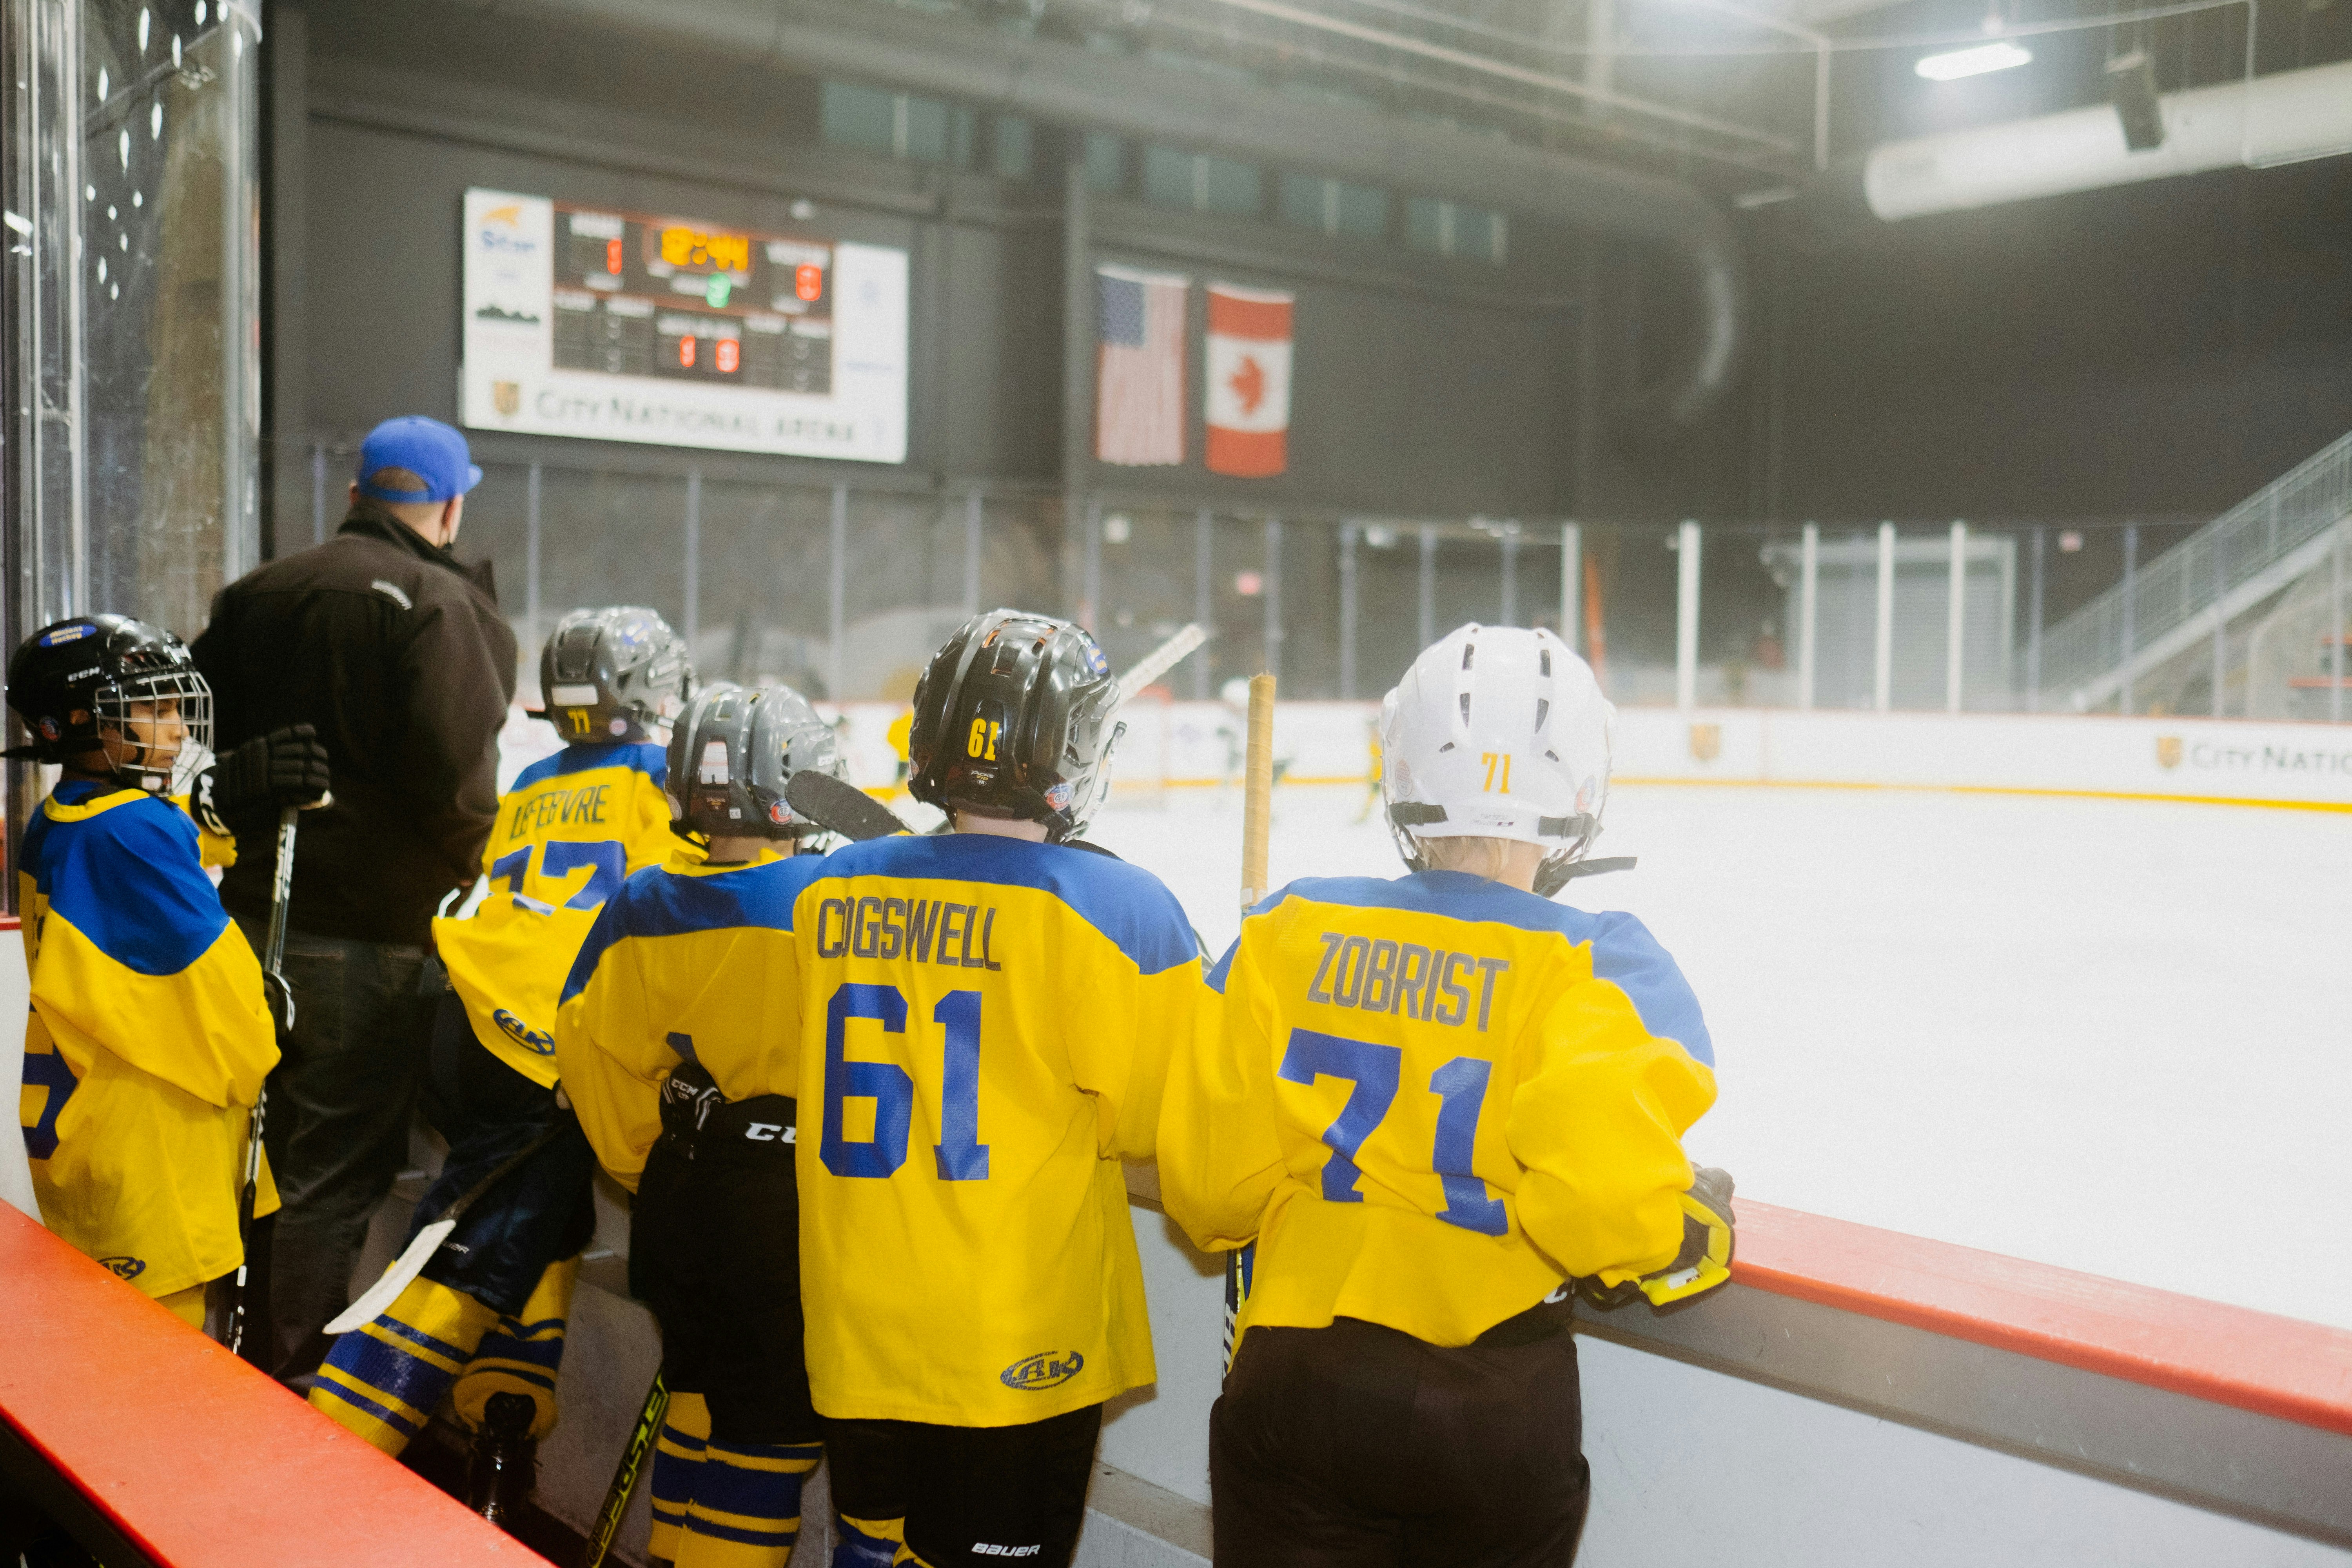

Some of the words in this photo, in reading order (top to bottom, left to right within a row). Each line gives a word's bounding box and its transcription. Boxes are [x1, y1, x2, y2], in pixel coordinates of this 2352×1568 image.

[968, 717, 1000, 761] 61
[1481, 752, 1510, 794] 71
[818, 896, 1002, 971] COGSWELL
[1307, 932, 1509, 1032] ZOBRIST
[671, 1078, 699, 1096] CCM
[819, 983, 990, 1181] 61
[1277, 1027, 1508, 1237] 71
